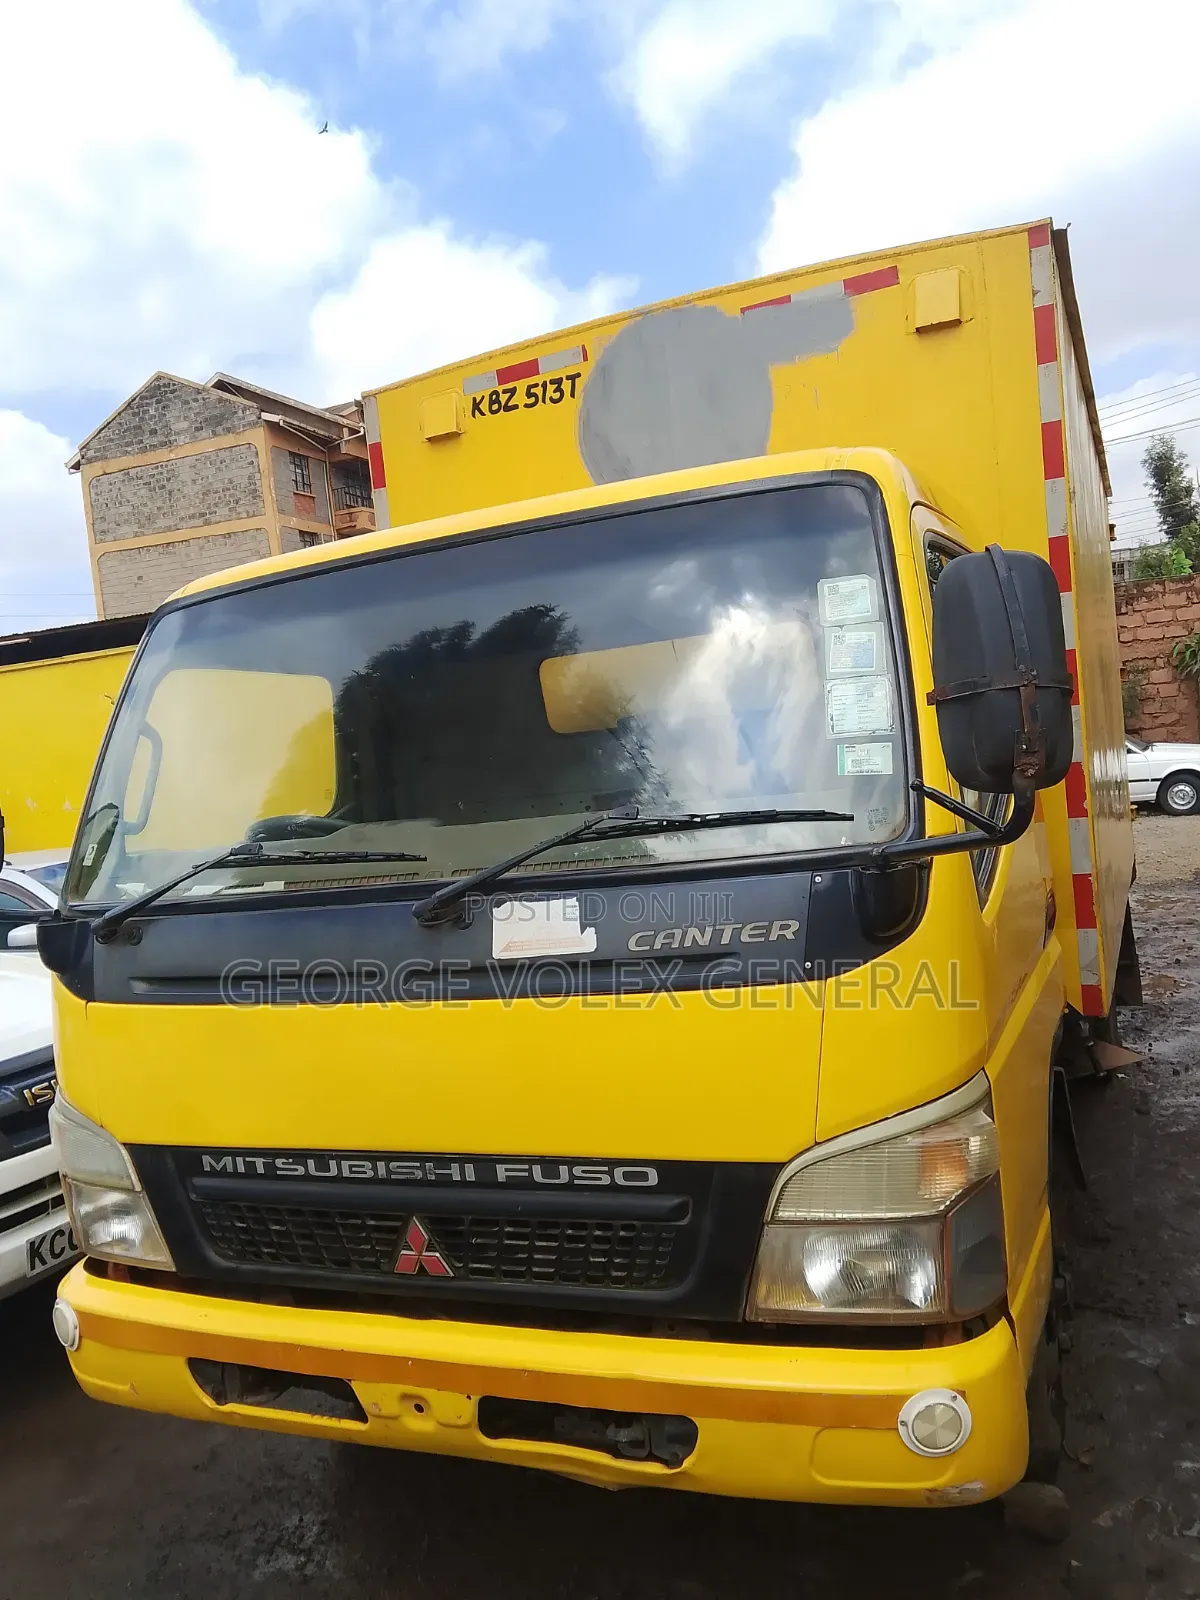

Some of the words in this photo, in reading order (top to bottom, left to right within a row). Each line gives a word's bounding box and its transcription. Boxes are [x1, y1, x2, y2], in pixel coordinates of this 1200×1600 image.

[471, 386, 519, 419] KBZ
[523, 372, 581, 408] 513T
[627, 919, 800, 952] CANTER
[23, 1079, 59, 1106] IS
[201, 1154, 476, 1182] MITSUBISHI
[495, 1163, 659, 1187] FUSO
